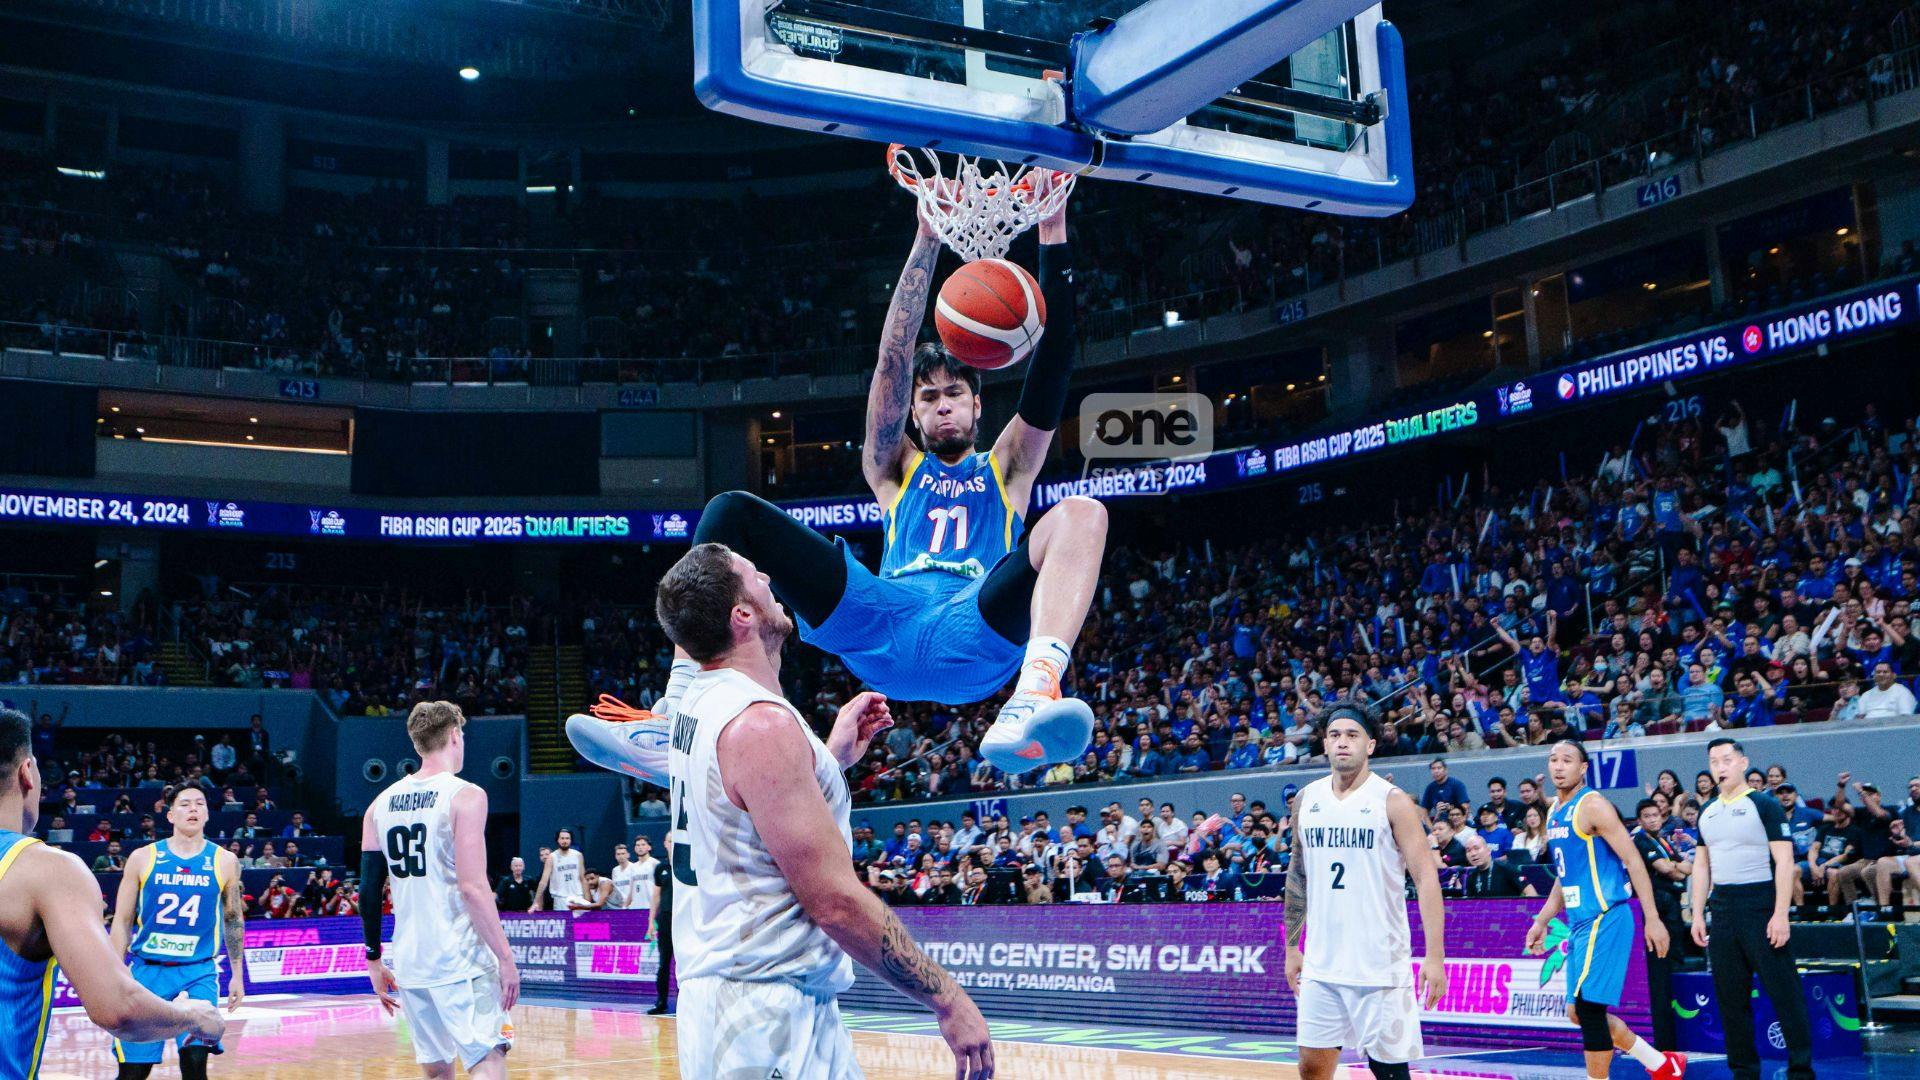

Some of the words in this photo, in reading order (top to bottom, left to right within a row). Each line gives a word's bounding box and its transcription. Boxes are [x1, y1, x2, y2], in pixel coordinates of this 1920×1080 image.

[1643, 177, 1677, 203] 416
[1281, 301, 1304, 321] 415
[1577, 343, 1698, 397] PHILIPPINES
[1700, 336, 1735, 366] VS.
[1767, 309, 1831, 350] HONG
[1835, 291, 1902, 333] KONG
[284, 380, 316, 399] 413
[1667, 396, 1701, 422] 216
[1274, 444, 1301, 471] FIBA
[1301, 438, 1328, 464] ASIA
[1328, 432, 1352, 458] CUP
[1353, 424, 1386, 452] 2025
[1385, 401, 1478, 445] QUALIFIERS
[919, 473, 986, 499] PIPINAS
[1046, 473, 1136, 504] NOVEMBER
[1138, 469, 1163, 492] 21,
[1164, 462, 1206, 488] 2024
[1298, 482, 1321, 504] 215
[108, 499, 139, 525] 24,
[143, 501, 190, 524] 2024
[787, 503, 856, 527] PPINES
[857, 501, 882, 522] VS
[380, 515, 413, 537] FIBA
[415, 516, 450, 537] ASIA
[452, 517, 482, 537] CUP
[484, 517, 523, 537] 2025
[523, 514, 630, 537] QUALIFIERS
[928, 505, 968, 554] 11
[265, 552, 297, 570] 213
[1588, 751, 1622, 789] 17
[387, 823, 427, 879] 93
[1304, 827, 1325, 849] NEW
[1328, 827, 1375, 850] ZEALAND
[154, 873, 211, 887] PILIPINAS
[1331, 862, 1345, 890] 2
[1185, 891, 1208, 901] POSS
[156, 892, 201, 927] 24
[500, 919, 567, 938] ONVENTION
[160, 938, 195, 952] Smart
[528, 945, 568, 965] CLARK
[989, 942, 1099, 974] CENTER,
[1107, 943, 1151, 971] SM
[1156, 944, 1268, 974] CLARK
[977, 971, 1014, 991] CITY,
[1016, 973, 1116, 993] PAMPANGA
[1511, 992, 1568, 1018] PHILIPPIN
